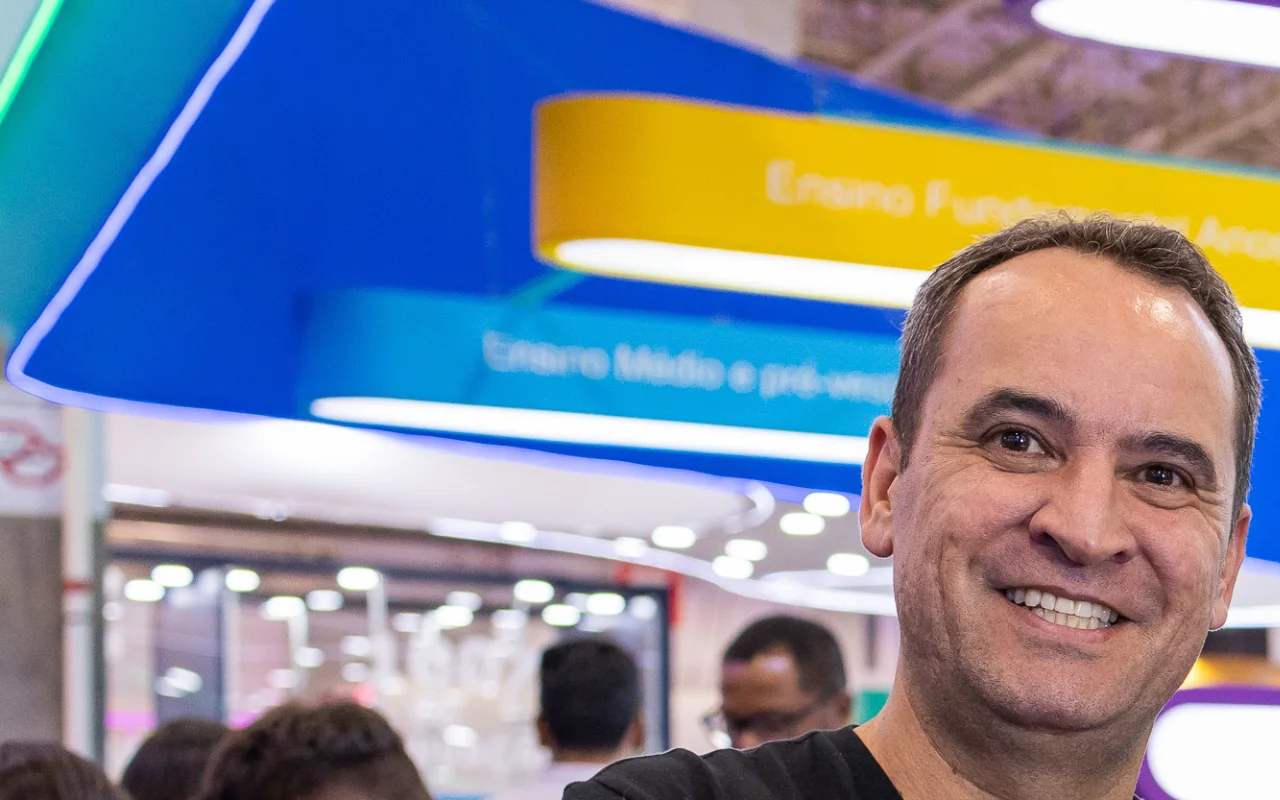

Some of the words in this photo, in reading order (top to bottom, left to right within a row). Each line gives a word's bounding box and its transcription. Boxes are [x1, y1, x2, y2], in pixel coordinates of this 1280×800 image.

[765, 159, 914, 219] Ensino
[482, 331, 610, 379] Ensino
[728, 360, 757, 393] e
